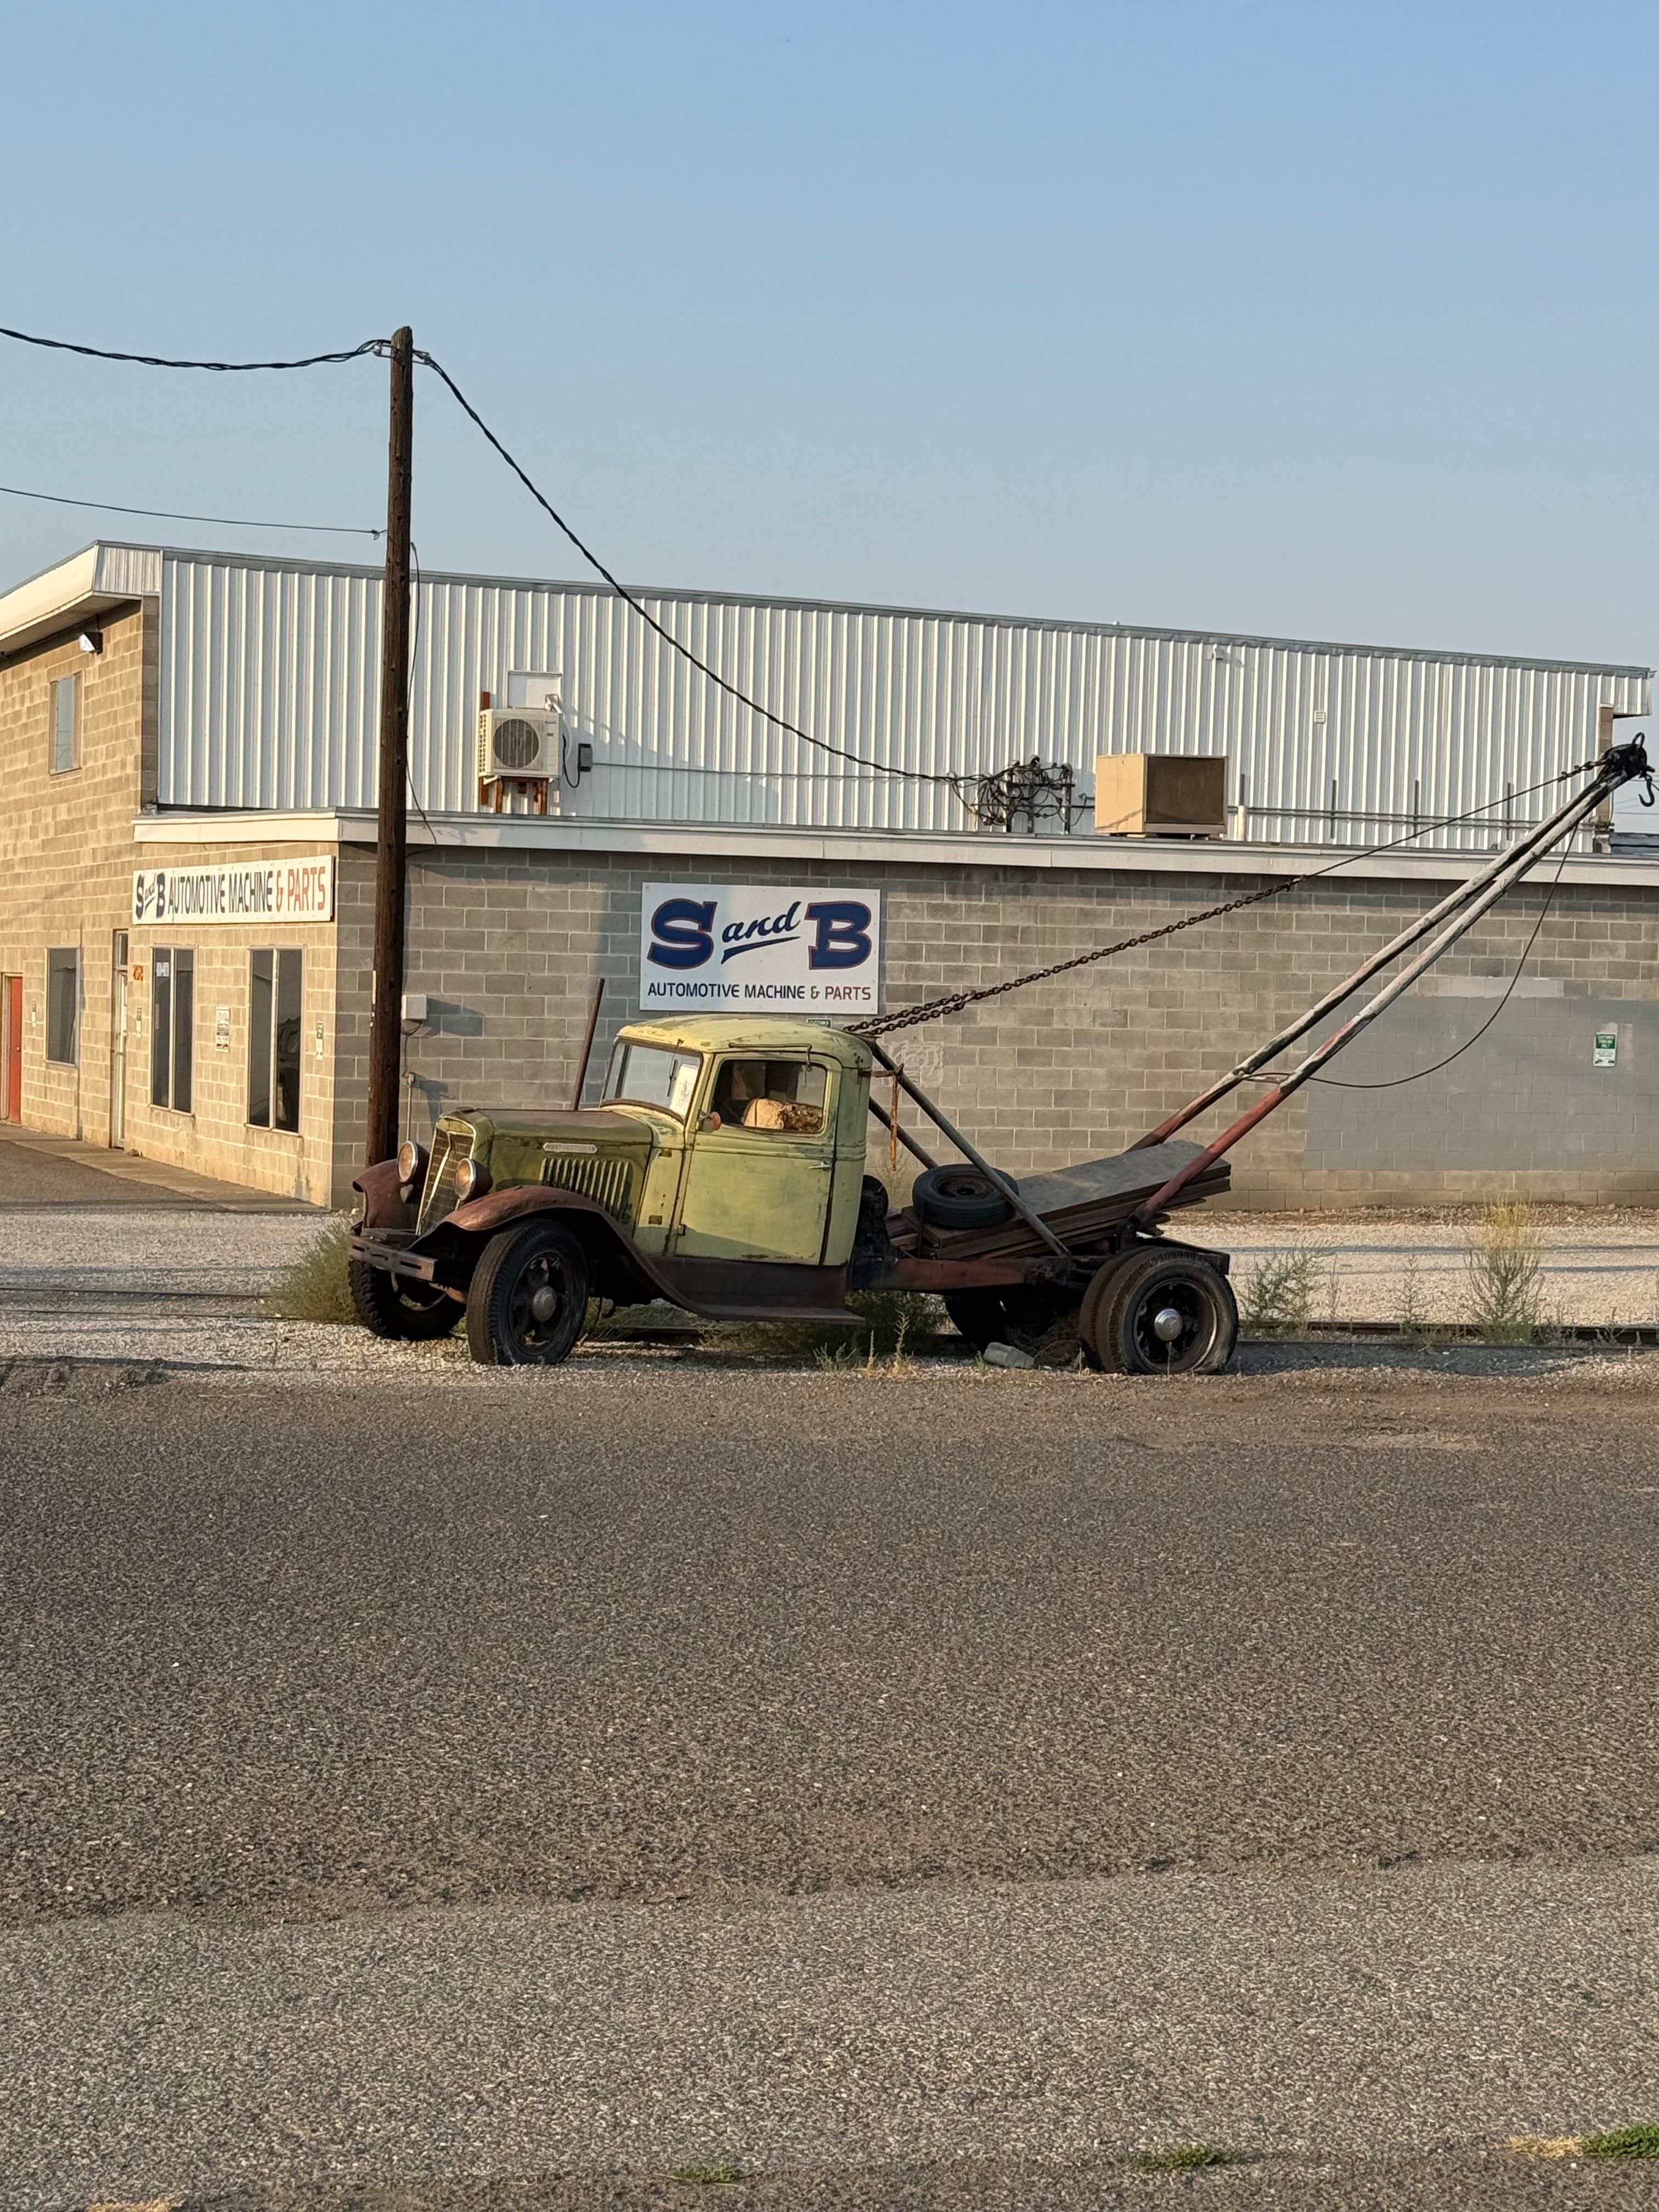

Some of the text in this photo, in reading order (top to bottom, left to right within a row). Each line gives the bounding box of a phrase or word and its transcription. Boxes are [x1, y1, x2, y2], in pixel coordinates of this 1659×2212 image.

[136, 873, 144, 919] S
[156, 872, 166, 918] B
[167, 874, 225, 914] AUTOMOTIVE
[228, 871, 273, 913] MACHINE
[276, 870, 284, 912] &
[287, 866, 326, 911] PARTS
[647, 898, 872, 970] S and B
[647, 983, 871, 1001] AUTOMOTIVE MACHINE & PARTS
